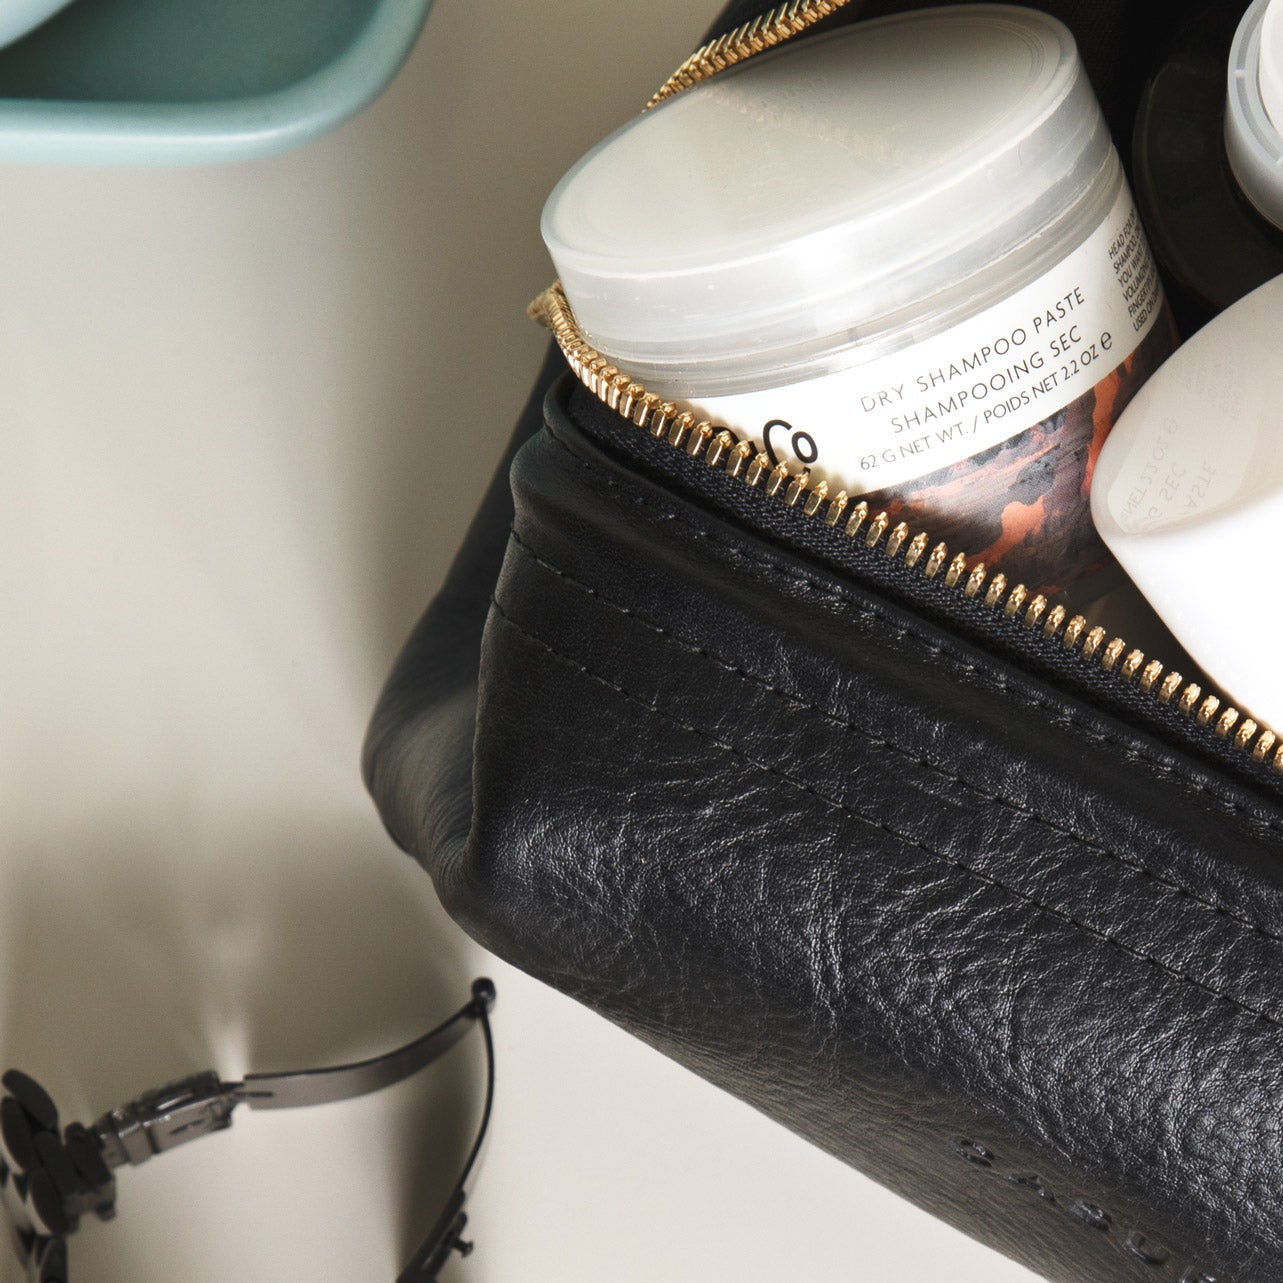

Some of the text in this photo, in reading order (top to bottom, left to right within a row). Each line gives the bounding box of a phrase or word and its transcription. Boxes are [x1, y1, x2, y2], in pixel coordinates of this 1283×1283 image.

[859, 286, 1085, 413] DRY SHAMPOO PASTE
[859, 454, 880, 471] 62
[882, 449, 897, 464] G
[900, 435, 932, 459] NET
[938, 421, 969, 441] WT.
[983, 390, 1030, 424] POIDS
[1032, 372, 1060, 399] NET
[1061, 359, 1080, 381] 2.2
[1080, 344, 1100, 366] OZ
[890, 324, 1082, 434] SHAMPOOING SEC
